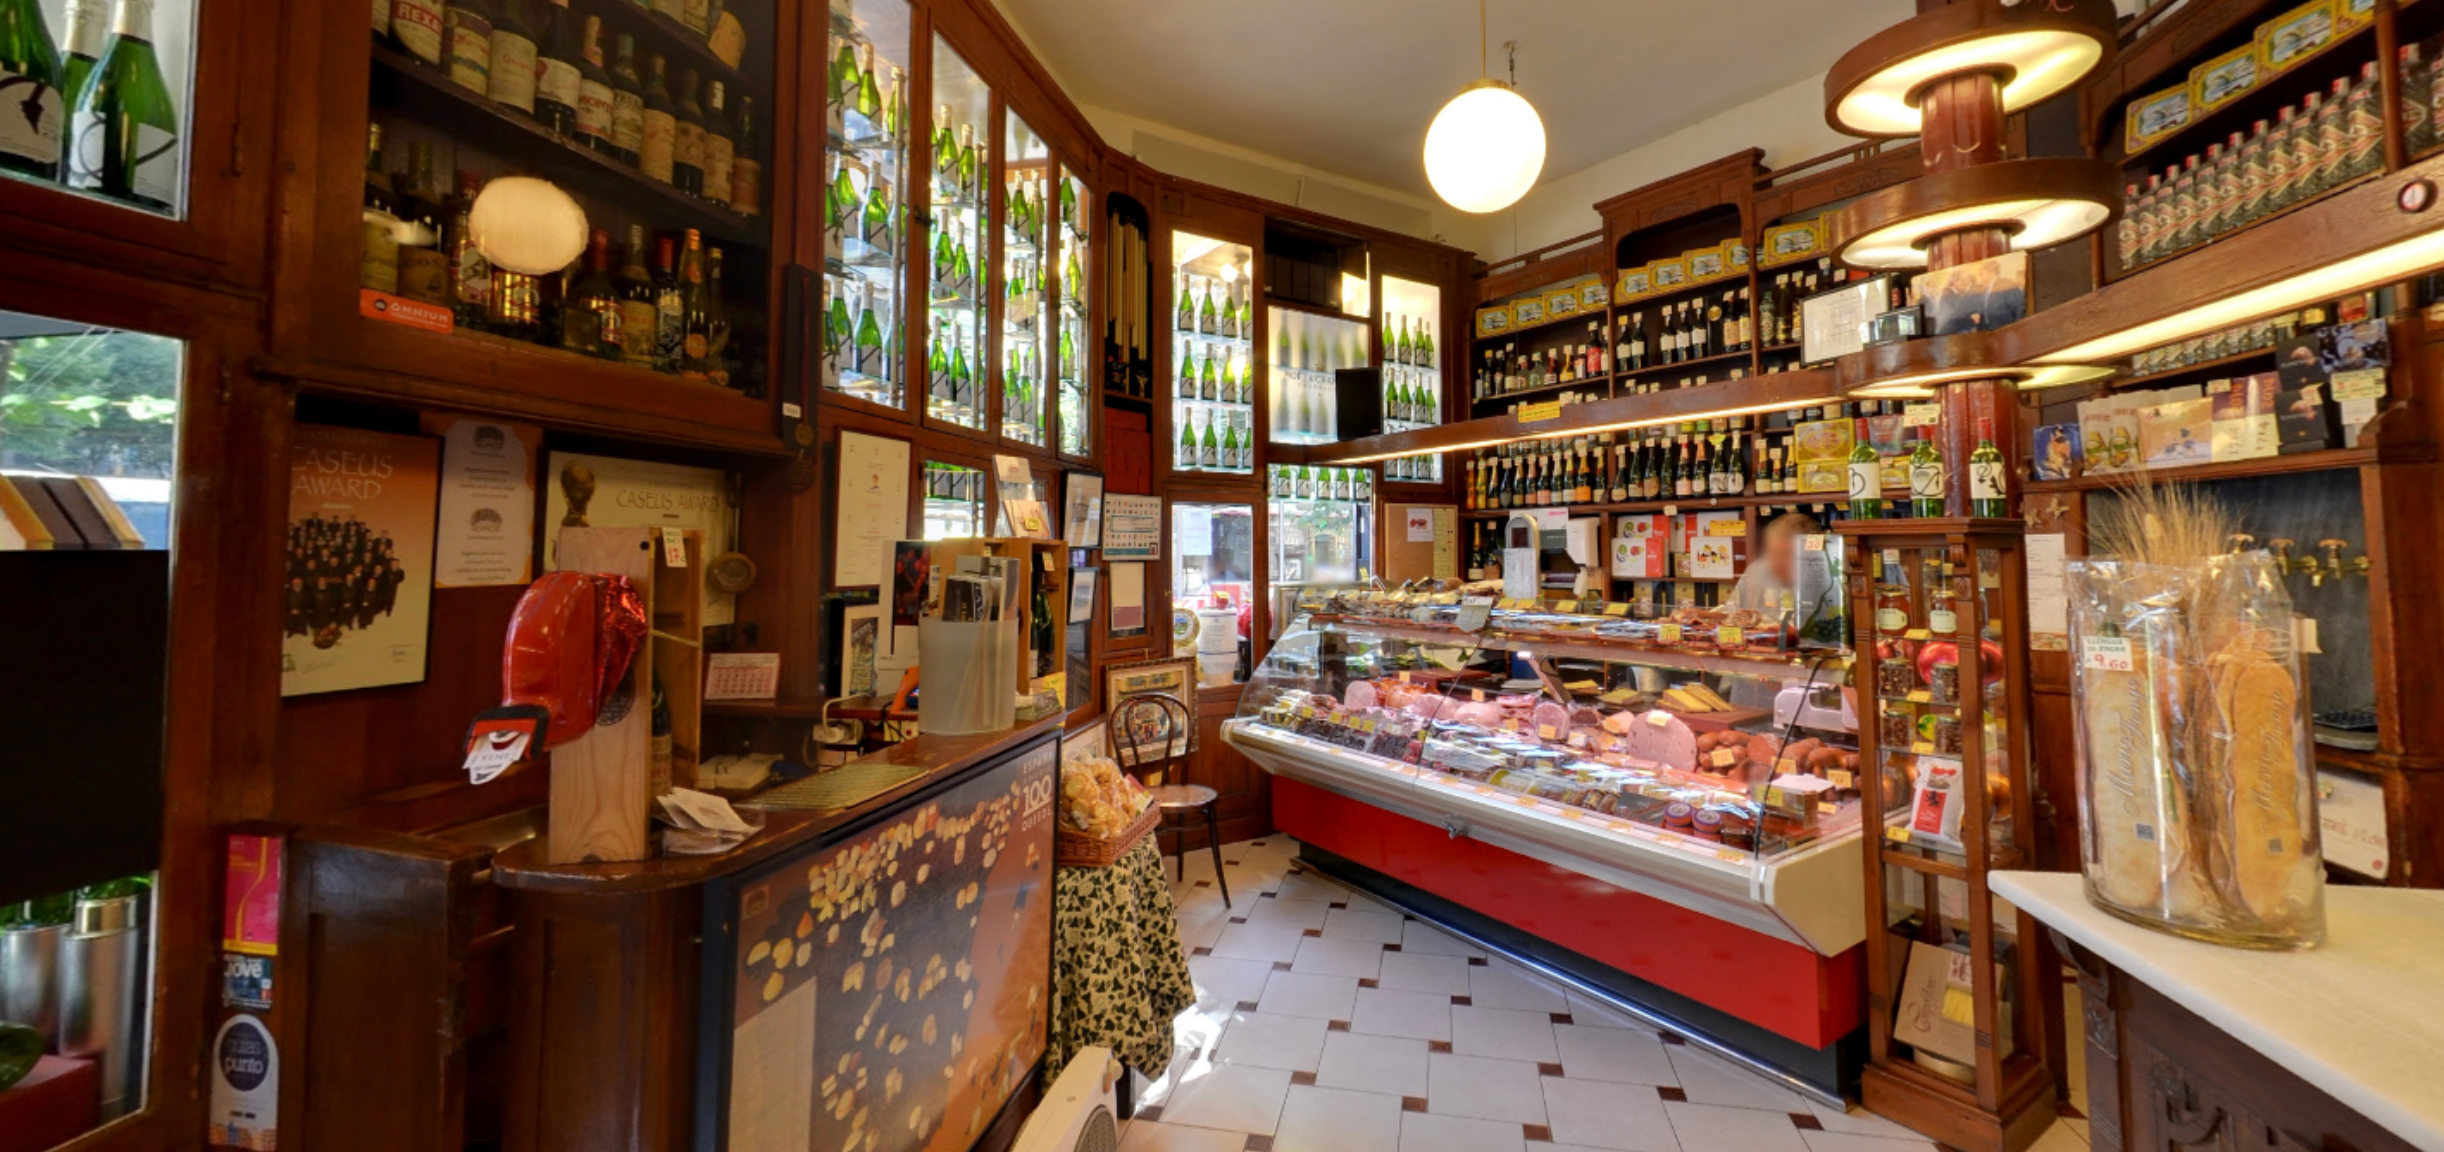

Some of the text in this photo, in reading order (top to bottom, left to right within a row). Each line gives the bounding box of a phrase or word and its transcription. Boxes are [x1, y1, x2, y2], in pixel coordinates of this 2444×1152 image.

[291, 475, 383, 500] AWARD
[616, 489, 673, 510] CASEUS
[1023, 774, 1052, 817] 100
